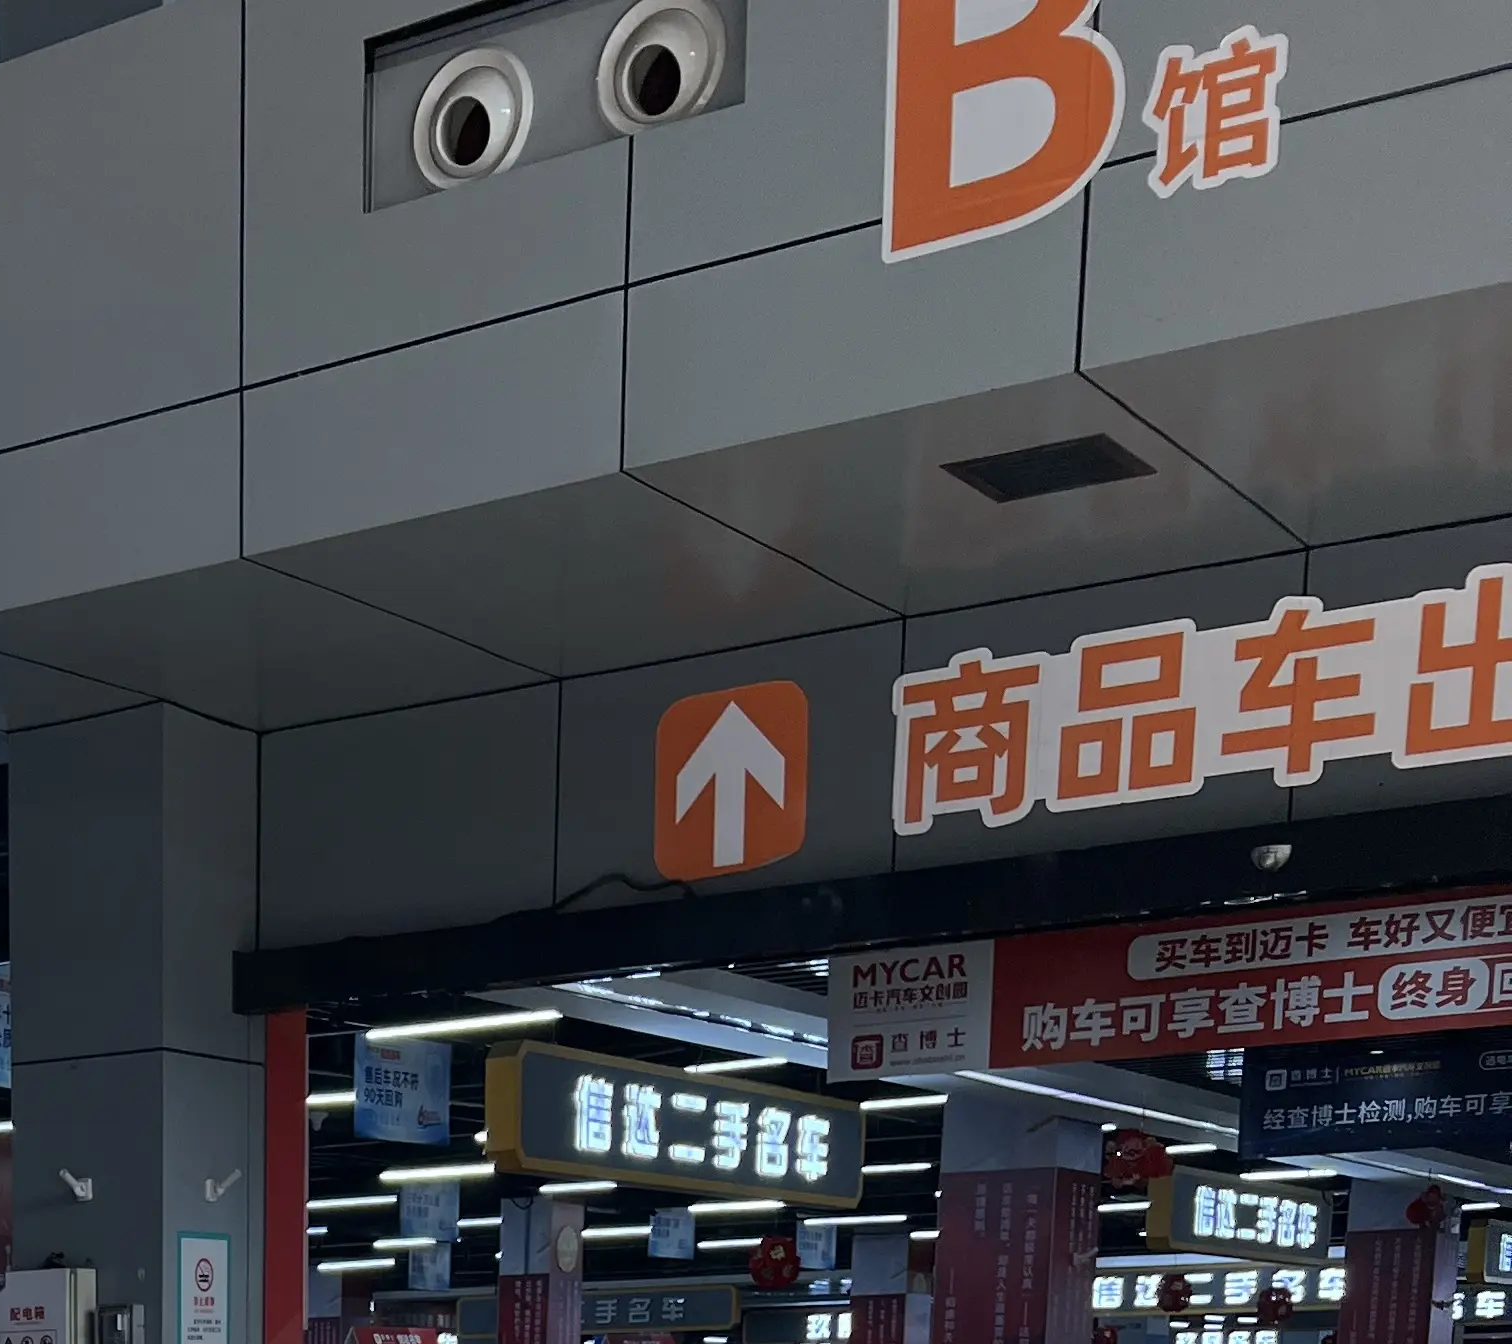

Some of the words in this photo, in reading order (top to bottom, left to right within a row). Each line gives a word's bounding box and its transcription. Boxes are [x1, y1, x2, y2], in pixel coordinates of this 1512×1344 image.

[853, 953, 966, 988] MYCAR
[1156, 922, 1329, 971] 买车到迈卡
[573, 1072, 831, 1183] 信达二手名车
[1194, 1185, 1318, 1249] 信达二手名车
[9, 1305, 46, 1322] 配电箱
